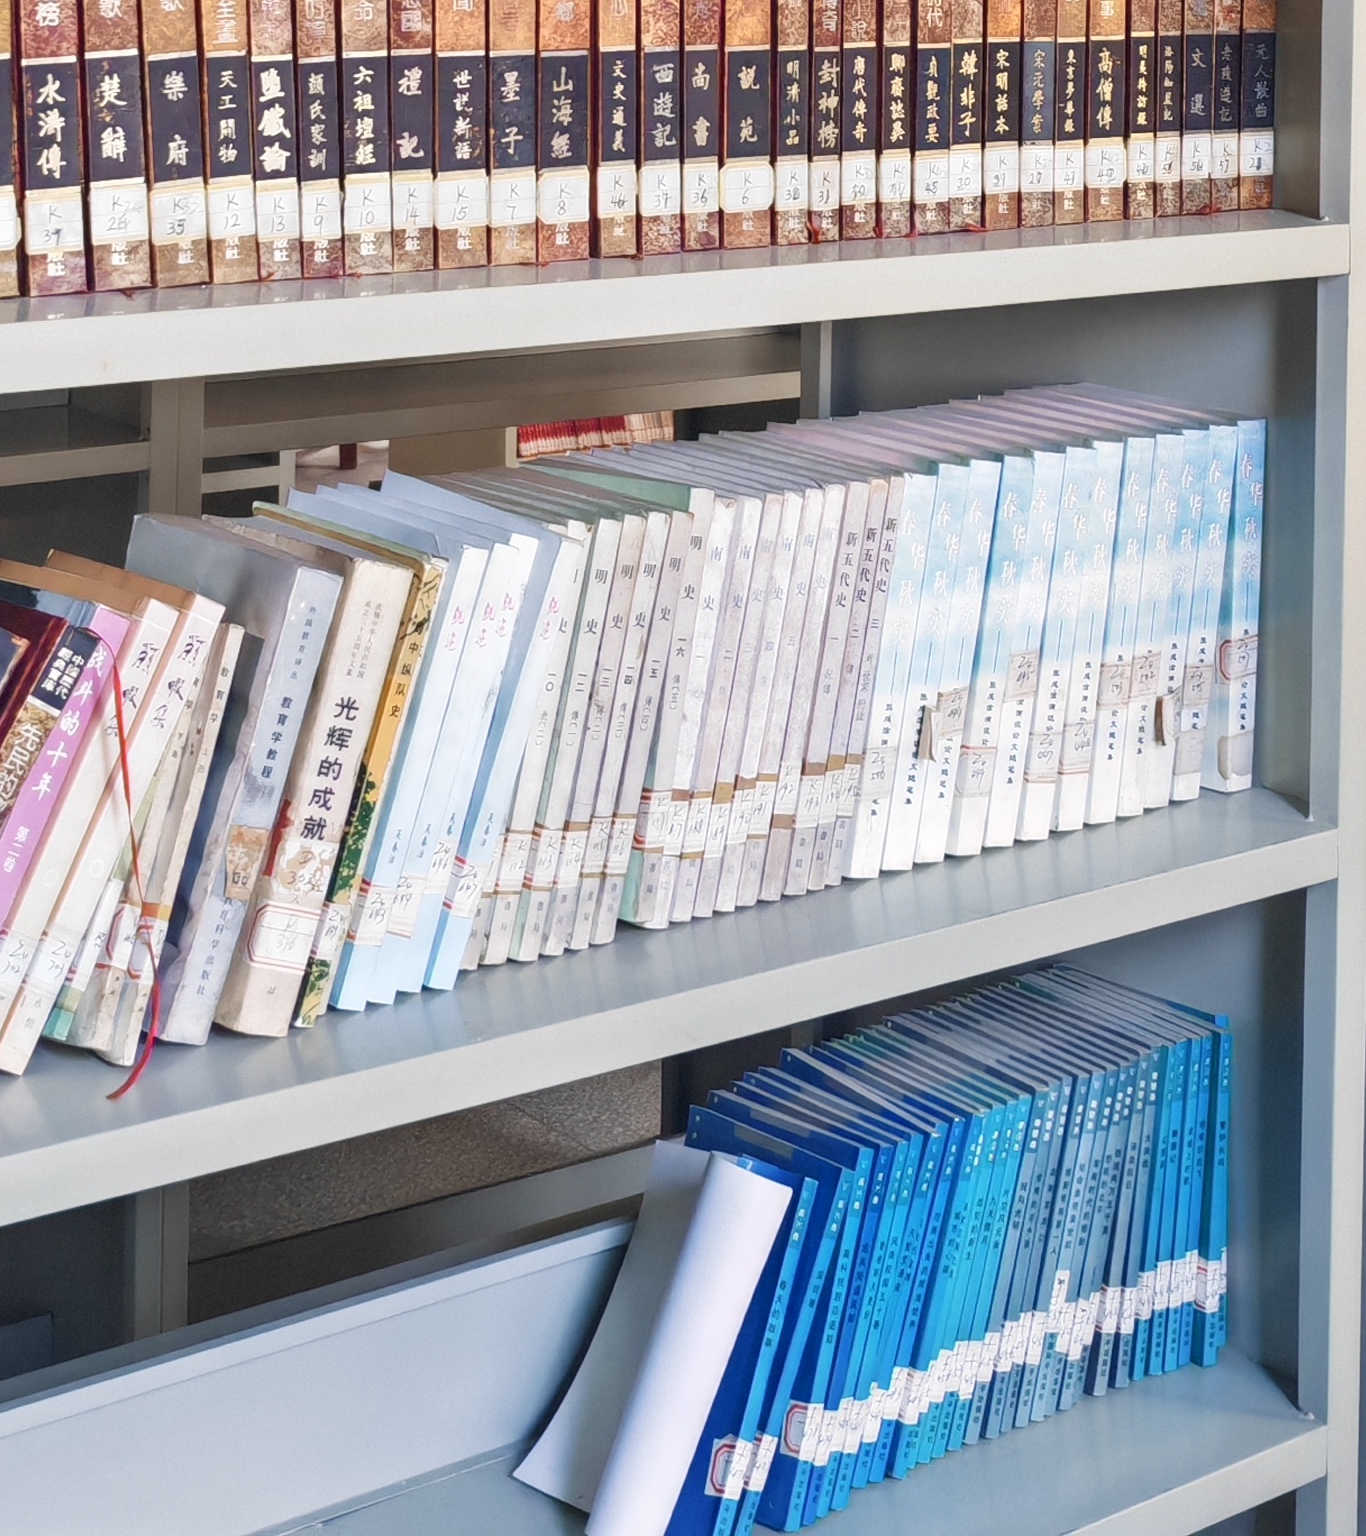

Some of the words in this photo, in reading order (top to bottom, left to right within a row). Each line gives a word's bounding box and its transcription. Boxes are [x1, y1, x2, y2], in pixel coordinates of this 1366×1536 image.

[162, 70, 188, 166] 樂府
[218, 70, 238, 164] 天工開物
[353, 66, 376, 166] 六祖壇經
[452, 69, 474, 160] 世說新語
[500, 71, 523, 155] 墨子
[550, 66, 574, 159] 山海經
[651, 64, 676, 148] 西遊記
[692, 63, 710, 147] 尚書
[784, 60, 800, 145] 明清小品
[818, 58, 839, 148] 封神榜
[958, 50, 978, 137] 韓非子
[1096, 47, 1113, 130] 高僧傳
[1190, 48, 1206, 116] 文選
[36, 74, 66, 180] 水滸傳
[610, 565, 634, 629] 明史
[633, 563, 657, 628] 明史
[658, 558, 681, 621] 明史
[681, 535, 702, 600] 明史
[835, 532, 858, 608] 新五代史
[856, 527, 877, 603] 新五代史
[875, 517, 897, 593] 新五代史
[585, 569, 608, 634] 明史
[32, 645, 107, 801] 战斗的十年
[261, 696, 293, 779] 教育学教程
[300, 696, 360, 841] 光辉的成就
